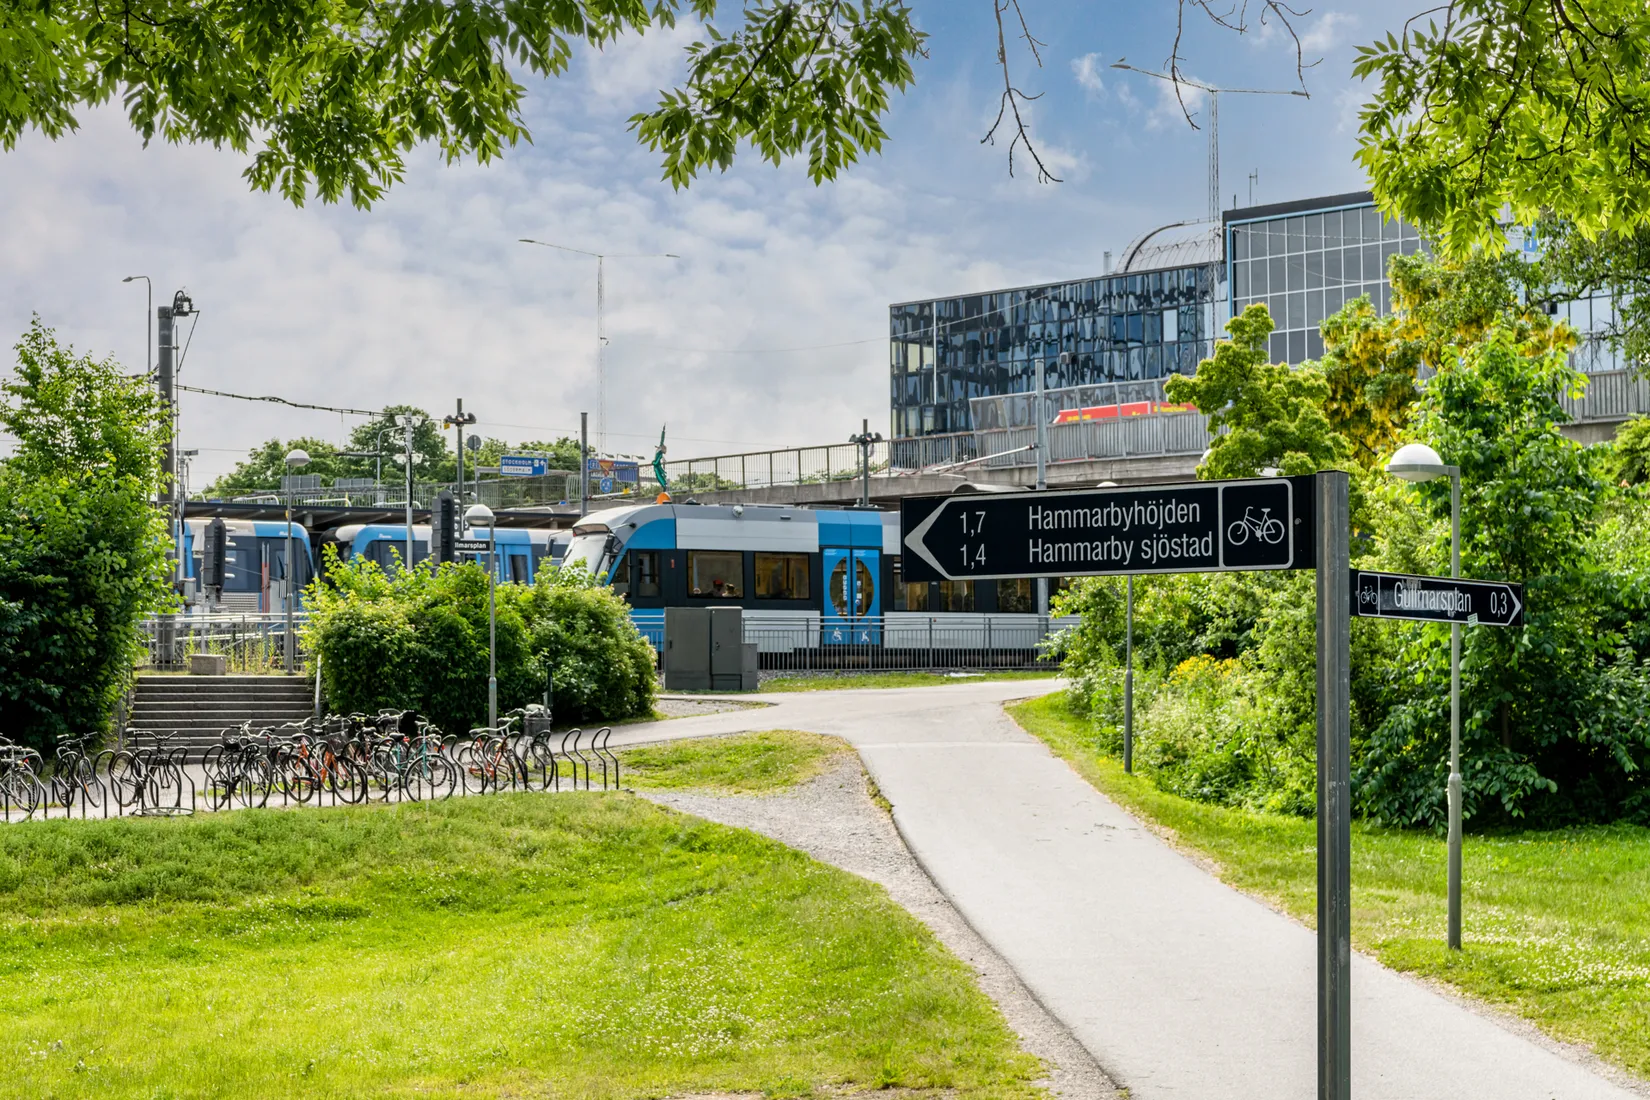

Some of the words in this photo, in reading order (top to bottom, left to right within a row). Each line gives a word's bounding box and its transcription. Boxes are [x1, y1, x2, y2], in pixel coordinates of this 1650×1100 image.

[960, 511, 986, 537] 1,7
[1028, 499, 1200, 531] Hammarbyhöjden
[454, 541, 487, 549] llmarsplan
[960, 543, 986, 569] 1,4
[1028, 535, 1134, 565] Hammarby
[1140, 531, 1213, 564] sjöstad
[1394, 581, 1472, 616] Gullmarsplan
[1490, 591, 1508, 617] 0,3
